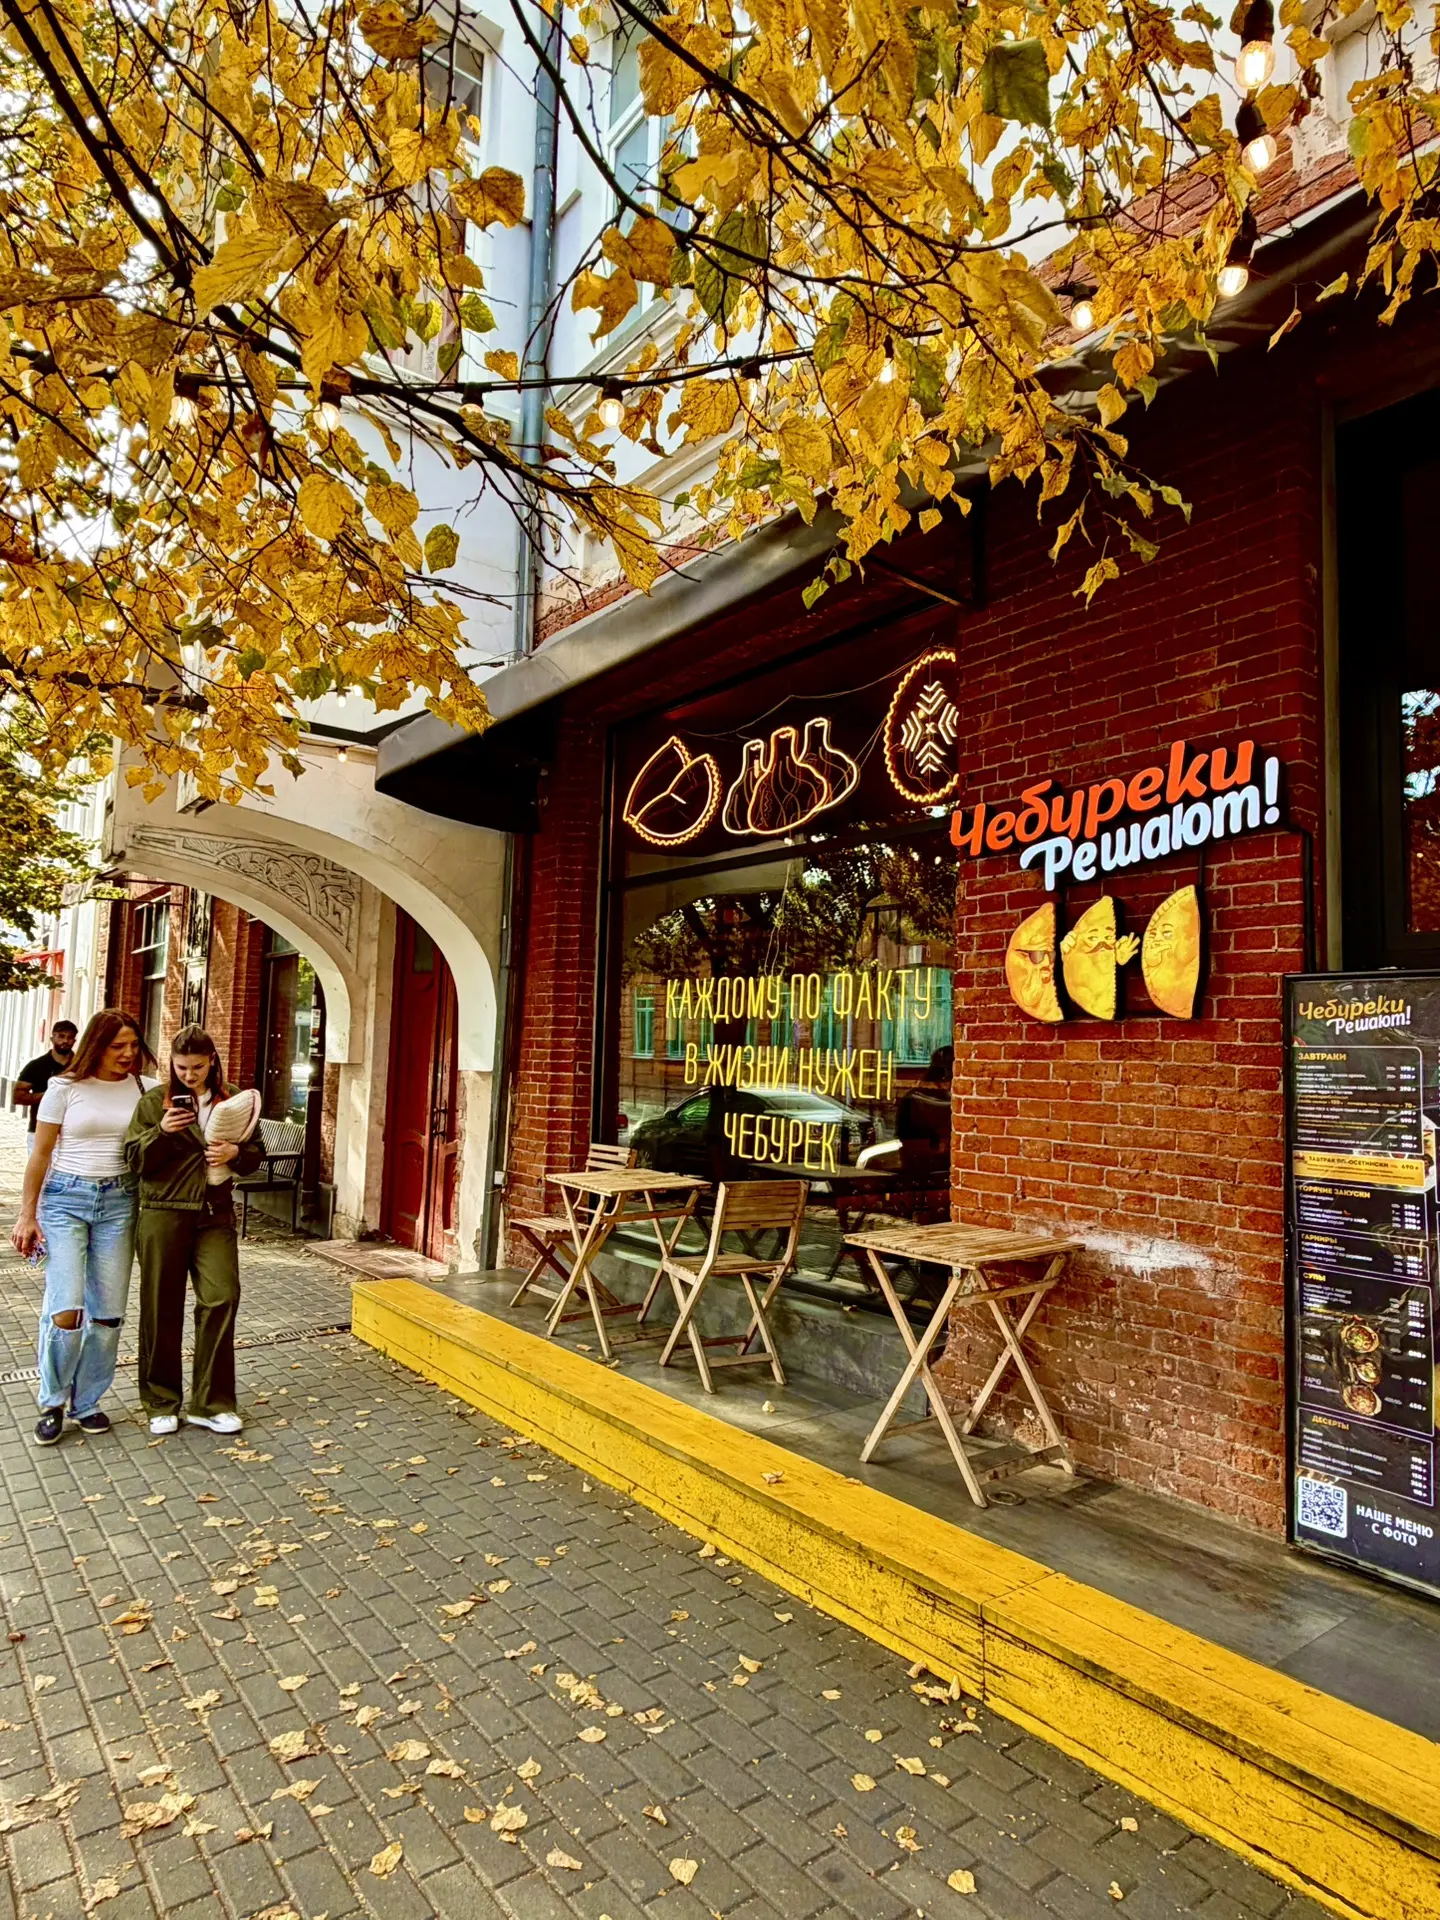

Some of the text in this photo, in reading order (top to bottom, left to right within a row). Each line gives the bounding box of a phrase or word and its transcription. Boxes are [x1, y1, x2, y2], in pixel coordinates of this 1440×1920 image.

[949, 740, 1254, 856] Чебуреки
[1020, 757, 1280, 891] Решают!
[666, 967, 933, 1024] КАЖДОМУ ПО ФАКТУ
[1298, 995, 1405, 1021] Чебуреки
[1326, 1006, 1412, 1035] Решают!
[1298, 1052, 1347, 1061] ЗАВТРАКИ
[684, 1044, 894, 1100] В ЖИЗНИ НУЖЕН
[723, 1111, 838, 1174] ЧЕБУРЕК
[1299, 1185, 1333, 1195] ГОРЯЧИЕ
[1334, 1188, 1371, 1199] ЗАКУСКИ
[1301, 1233, 1337, 1244] ГАРНИРЫ
[1312, 1415, 1349, 1430] ДЕСЕРТЫ
[1356, 1504, 1434, 1538] НАШЕ МЕНЮ
[1371, 1523, 1418, 1547] С ФОТО
